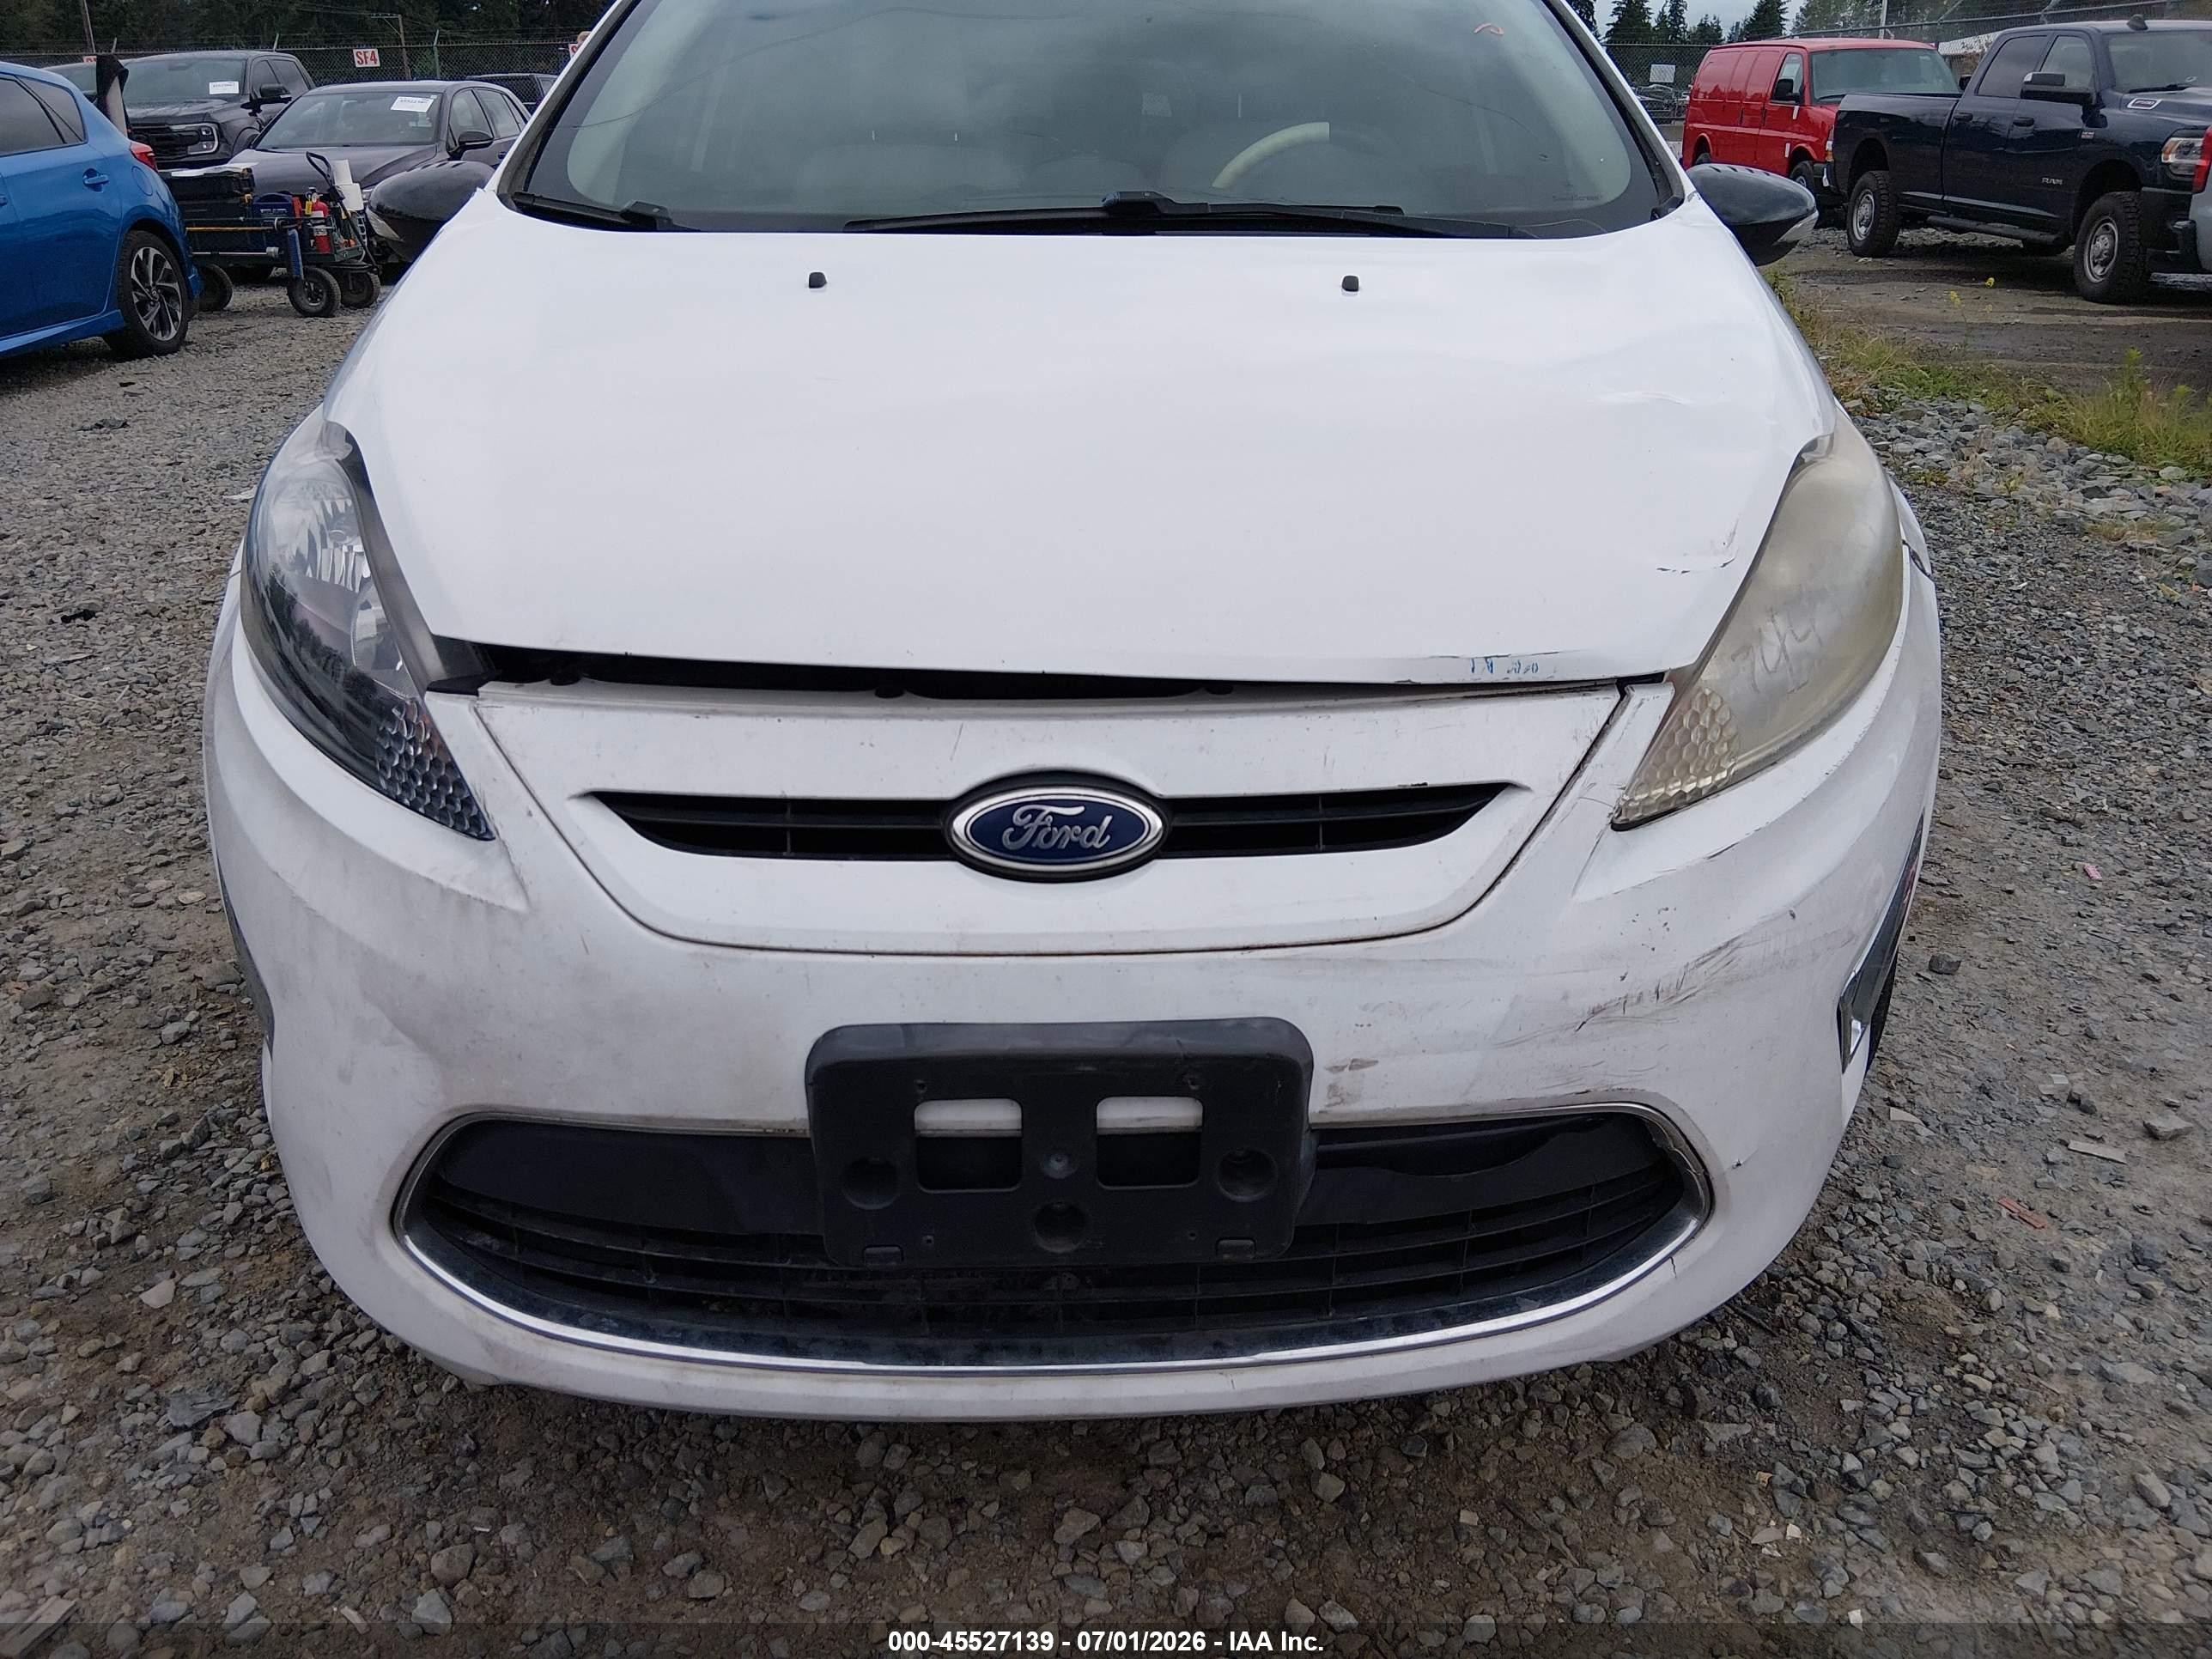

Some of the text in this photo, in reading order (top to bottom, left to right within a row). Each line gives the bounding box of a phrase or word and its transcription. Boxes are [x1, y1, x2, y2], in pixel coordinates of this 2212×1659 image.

[356, 50, 378, 64] SF4
[2041, 177, 2063, 185] RAM
[1001, 804, 1114, 850] Ford
